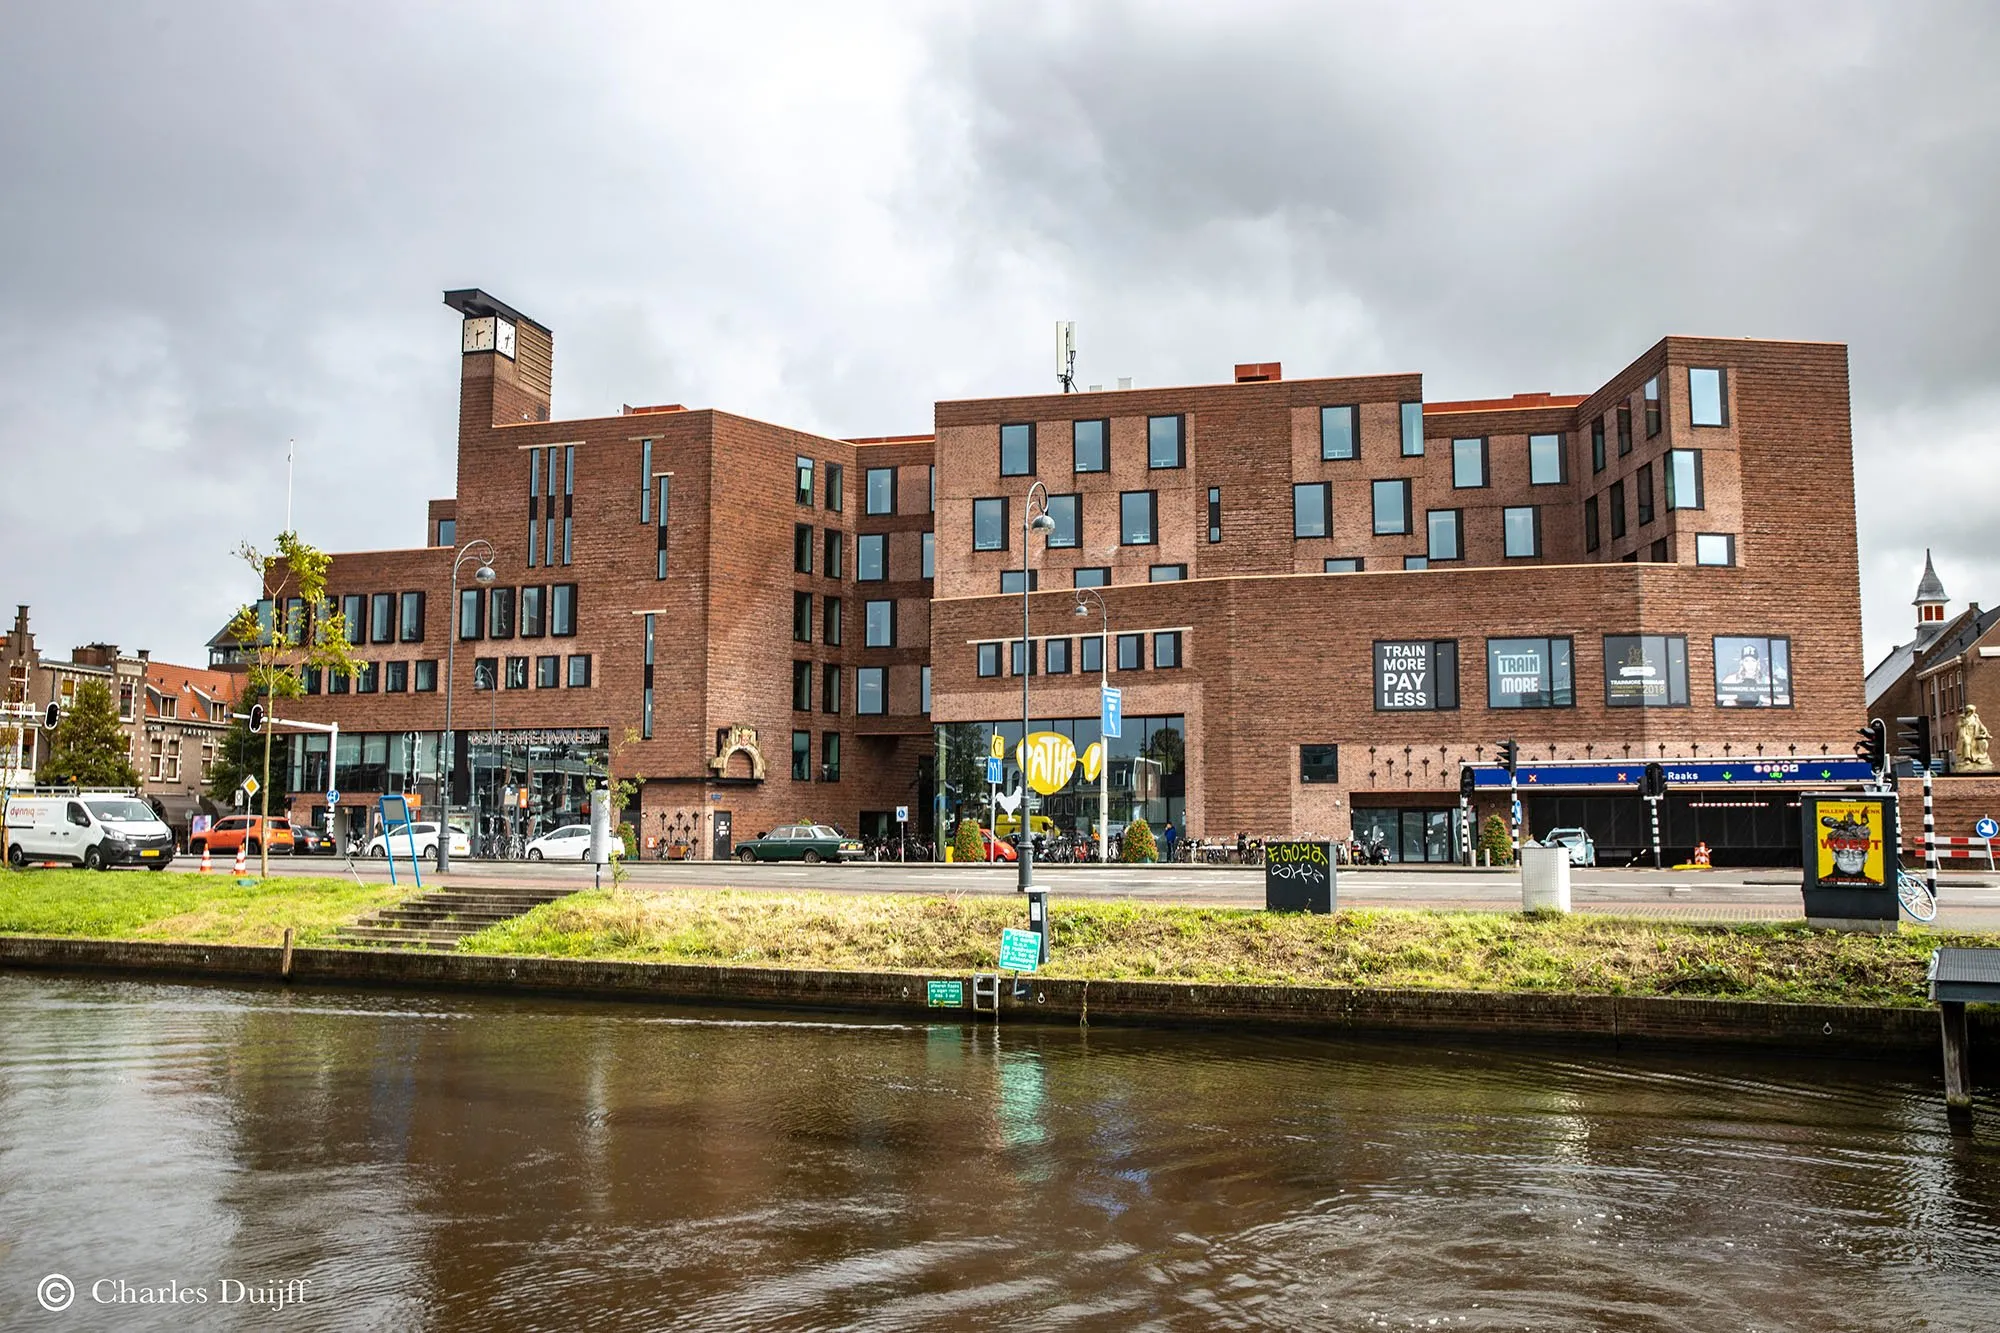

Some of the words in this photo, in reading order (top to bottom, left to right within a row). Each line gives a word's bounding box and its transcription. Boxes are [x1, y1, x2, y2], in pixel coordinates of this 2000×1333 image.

[1384, 645, 1426, 658] TRAIN
[1384, 658, 1426, 671] MORE
[1500, 656, 1539, 673] TRAIN
[1384, 673, 1426, 691] PAY
[1501, 677, 1539, 693] MORE
[1643, 685, 1665, 694] 2018
[1384, 692, 1427, 706] LESS
[471, 731, 541, 746] GEMEENTE
[542, 730, 601, 745] HAARLEM
[1667, 771, 1699, 781] Raaks
[1820, 838, 1882, 851] WOEST
